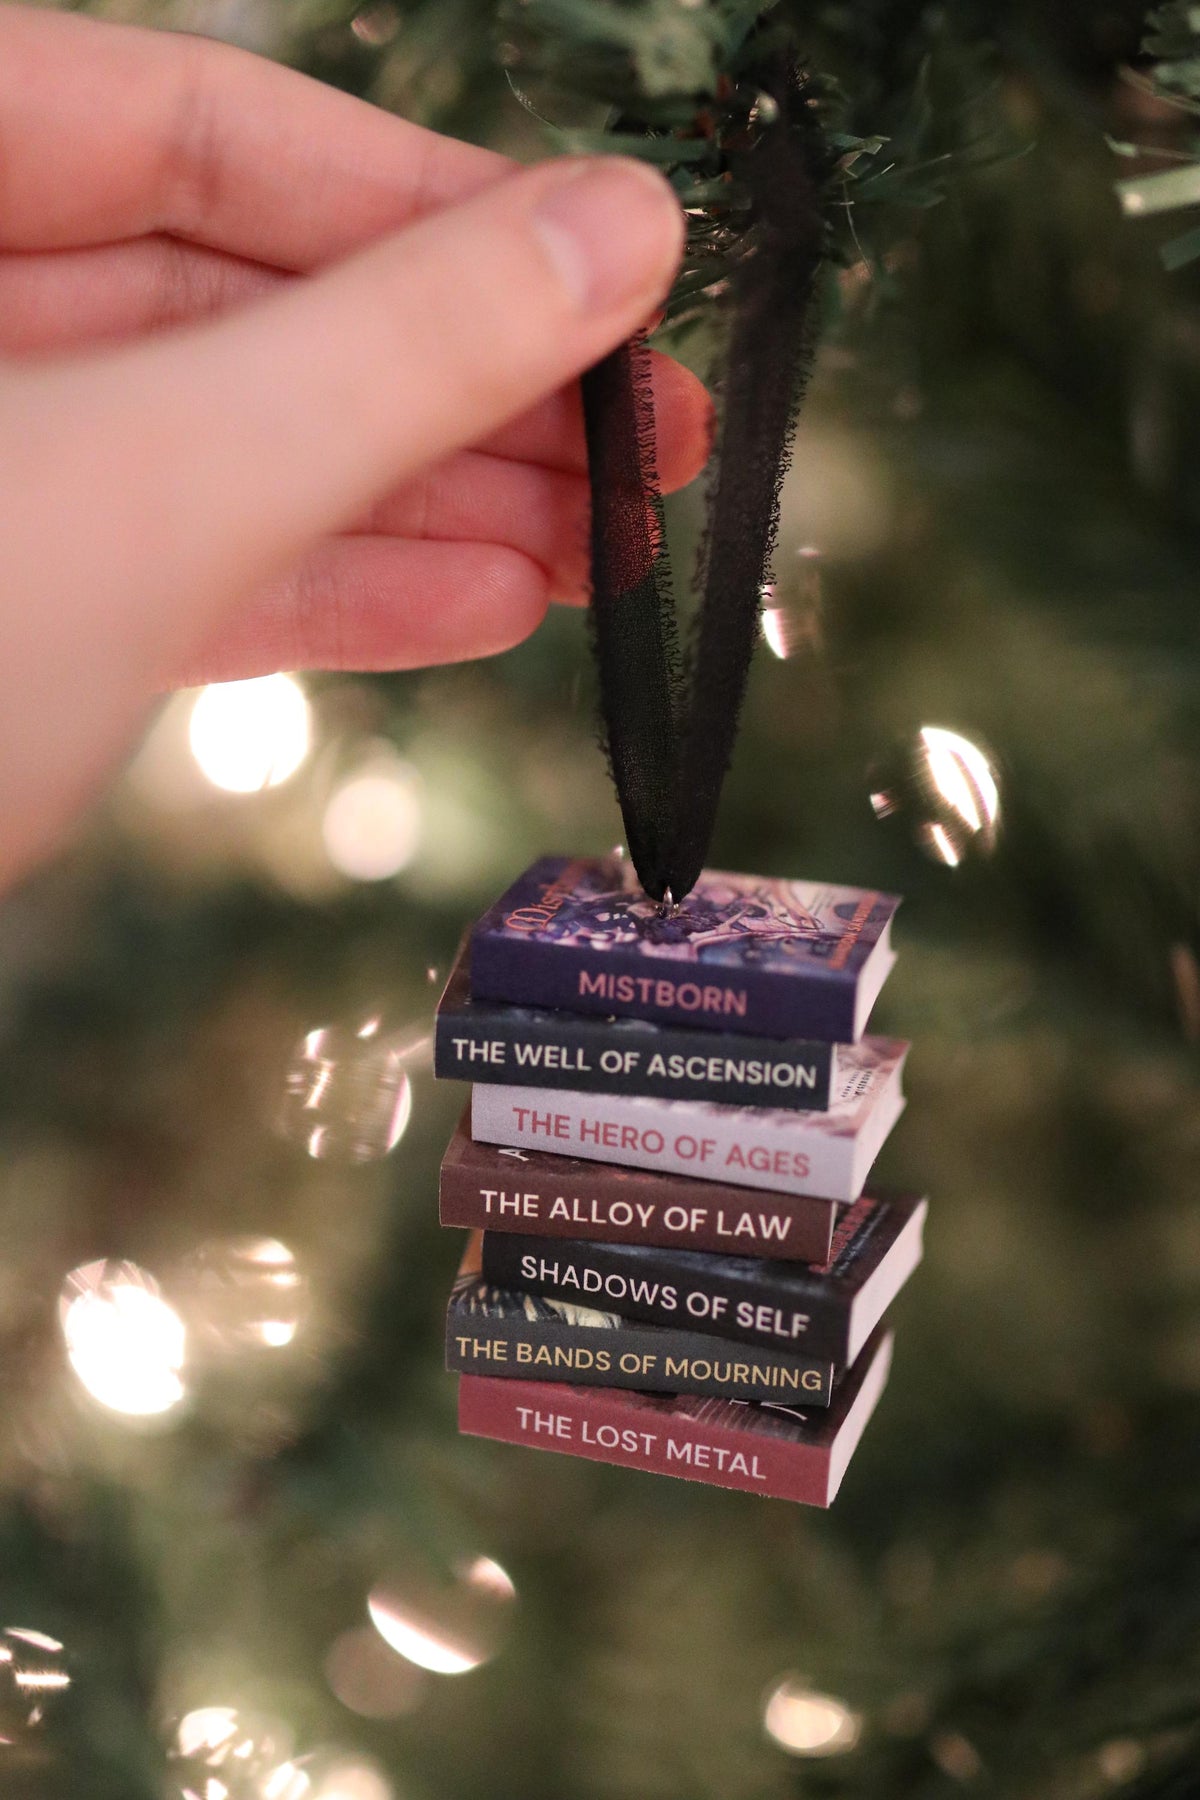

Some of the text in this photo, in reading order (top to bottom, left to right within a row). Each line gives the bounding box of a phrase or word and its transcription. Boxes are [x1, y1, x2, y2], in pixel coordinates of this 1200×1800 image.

[578, 970, 747, 1016] MISTBORN
[452, 1038, 506, 1064] THE
[514, 1043, 592, 1072] WELL
[600, 1050, 641, 1075] OF
[646, 1053, 817, 1089] ASCENSION
[512, 1107, 810, 1178] THE HERO OF AGES
[479, 1189, 793, 1241] THE ALLOY OF LAW
[520, 1255, 811, 1339] SHADOWS OF SELF
[455, 1336, 822, 1391] THE BANDS OF MOURNING
[515, 1407, 768, 1480] THE LOST METAL
